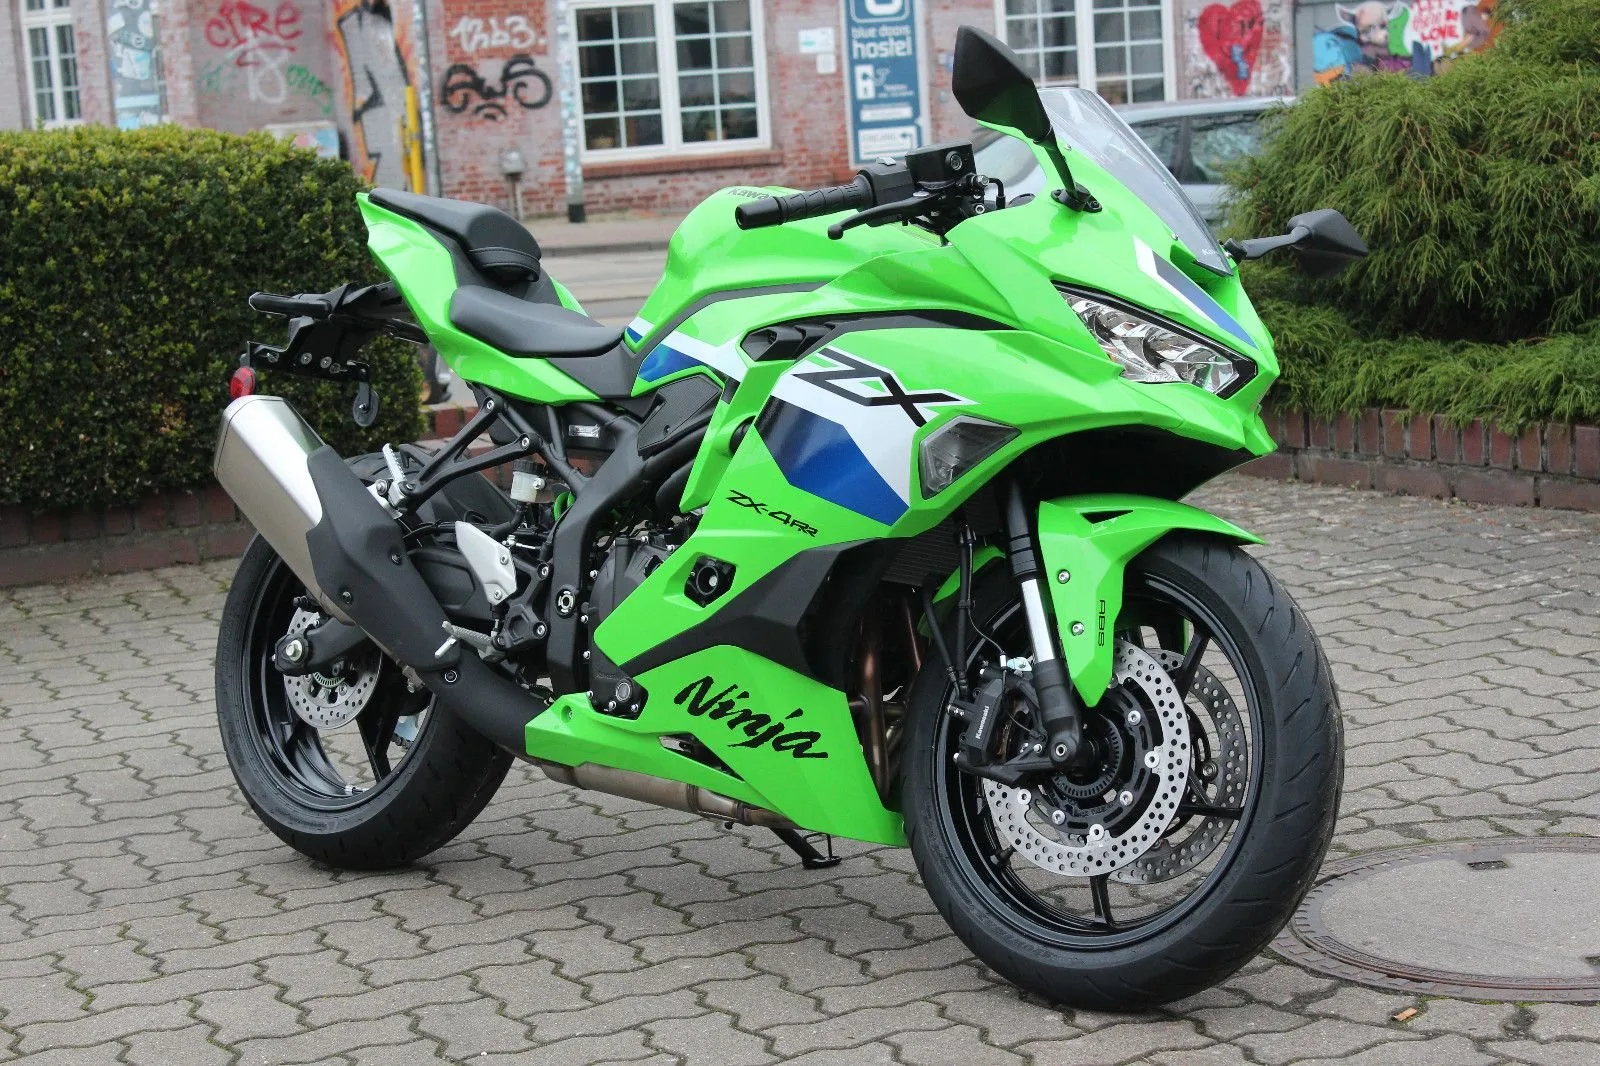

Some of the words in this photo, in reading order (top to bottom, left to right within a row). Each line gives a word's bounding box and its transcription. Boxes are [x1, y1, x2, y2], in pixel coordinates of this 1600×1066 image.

[853, 36, 912, 59] hostel
[792, 347, 962, 428] ZX
[726, 490, 818, 537] ZX-4RR
[1098, 600, 1106, 646] ABS
[674, 676, 829, 758] Ninja
[975, 705, 990, 739] Kawasaki
